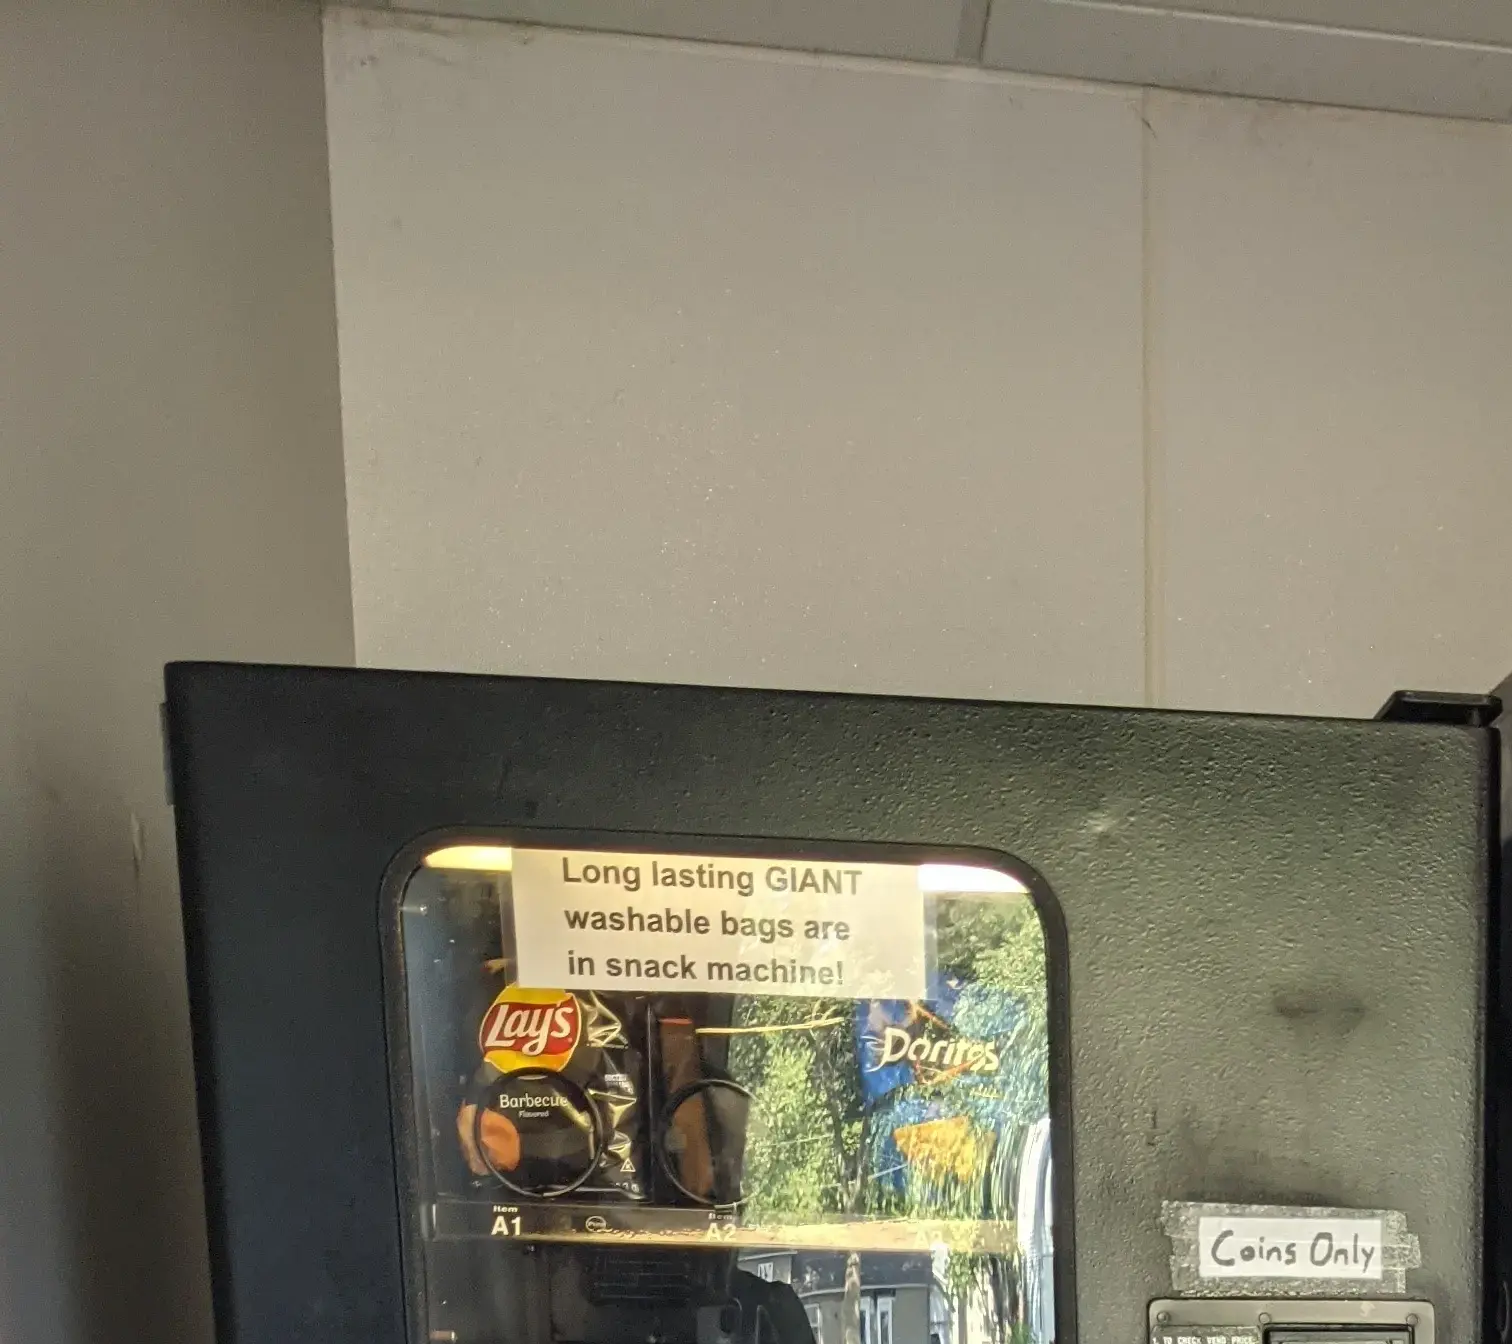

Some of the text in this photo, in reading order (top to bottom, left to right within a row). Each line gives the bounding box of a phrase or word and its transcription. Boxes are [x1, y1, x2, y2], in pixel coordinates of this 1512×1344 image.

[562, 857, 862, 897] Long lasting GIANT
[565, 907, 850, 943] washable bags are
[568, 950, 843, 985] in snack machine!
[485, 1001, 574, 1056] Lay's
[868, 1027, 1000, 1072] Doritos
[500, 1094, 568, 1109] Barbecue
[491, 1216, 521, 1236] A1
[493, 1205, 518, 1213] Item
[705, 1222, 737, 1242] A2
[1211, 1230, 1375, 1273] Coins Only
[1163, 1336, 1172, 1344] TO
[1177, 1336, 1202, 1344] CHECK
[1207, 1336, 1226, 1344] VEND
